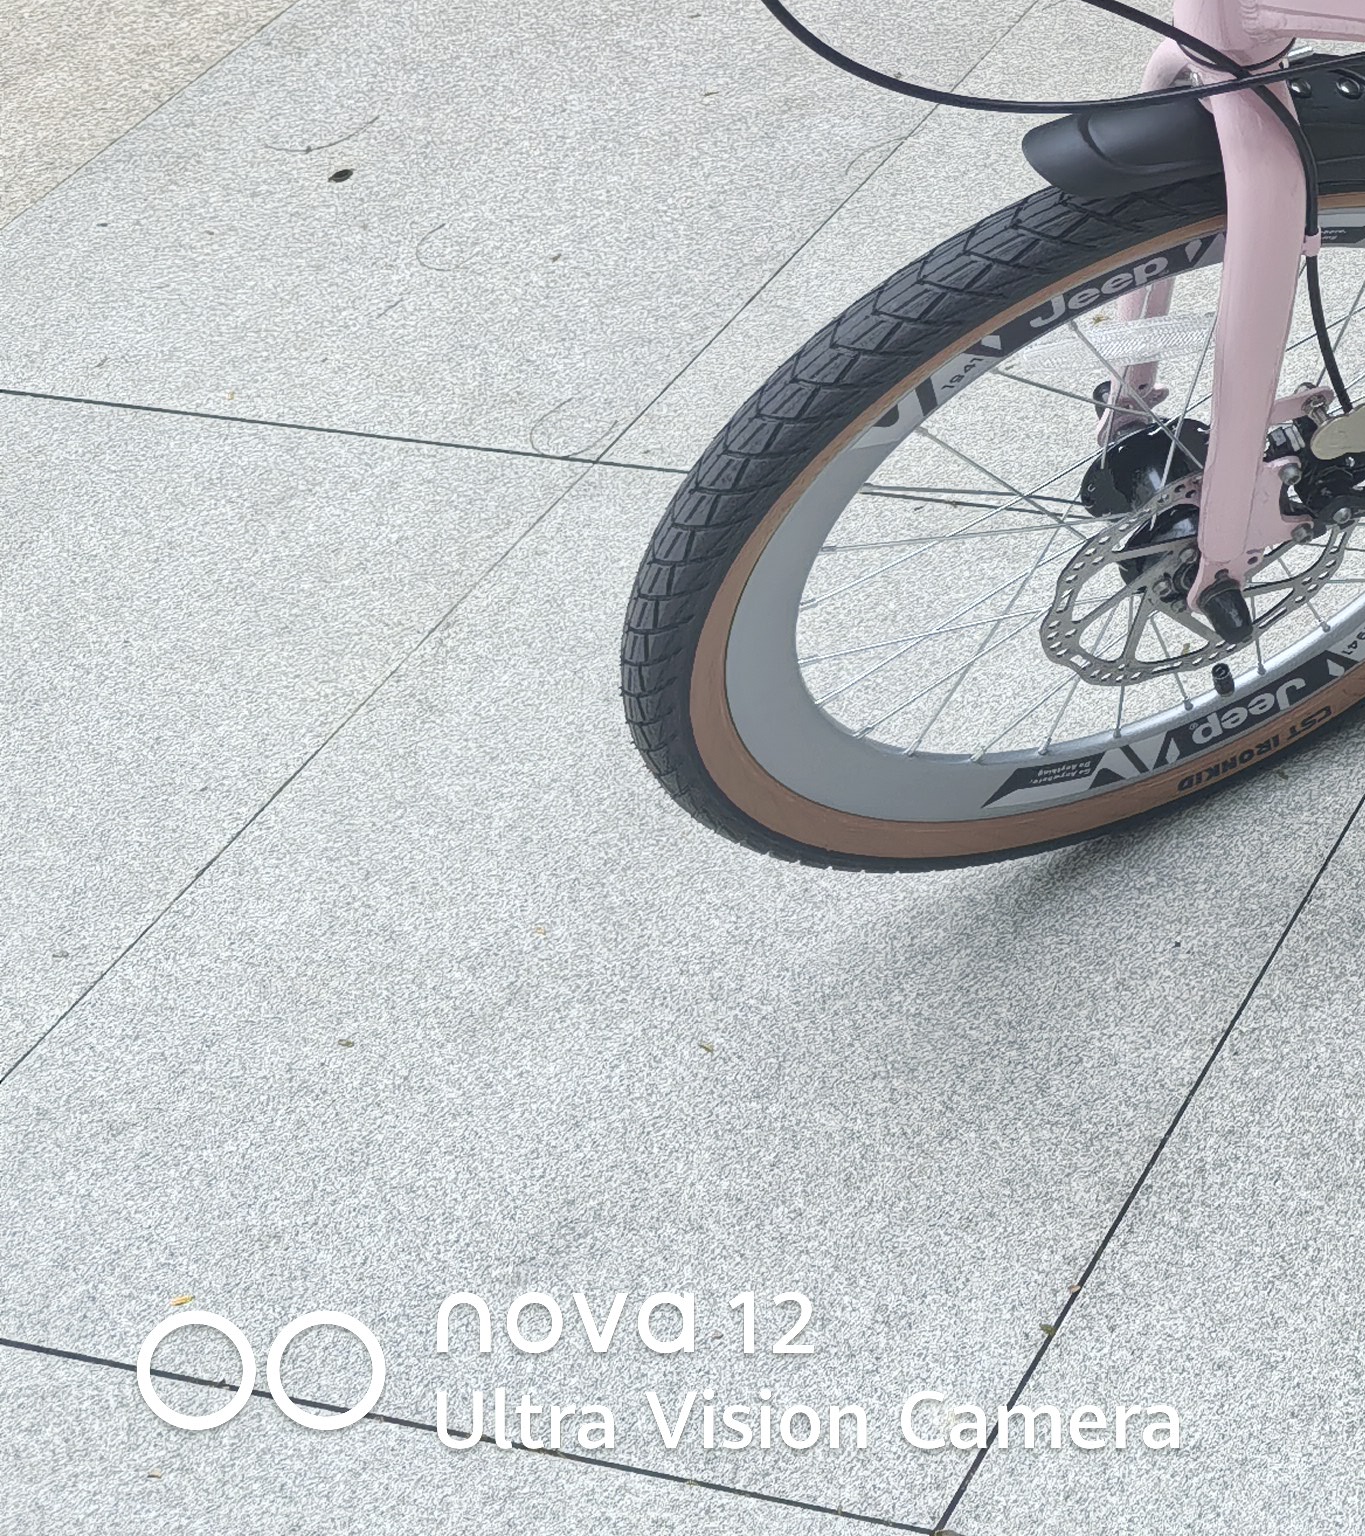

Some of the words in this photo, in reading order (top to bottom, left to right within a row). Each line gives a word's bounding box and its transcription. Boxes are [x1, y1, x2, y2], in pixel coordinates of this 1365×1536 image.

[941, 357, 985, 391] 1941
[1029, 255, 1169, 329] Jeep
[1191, 677, 1307, 746] Jeep
[1287, 706, 1333, 740] CST
[1177, 736, 1281, 792] IRONKID
